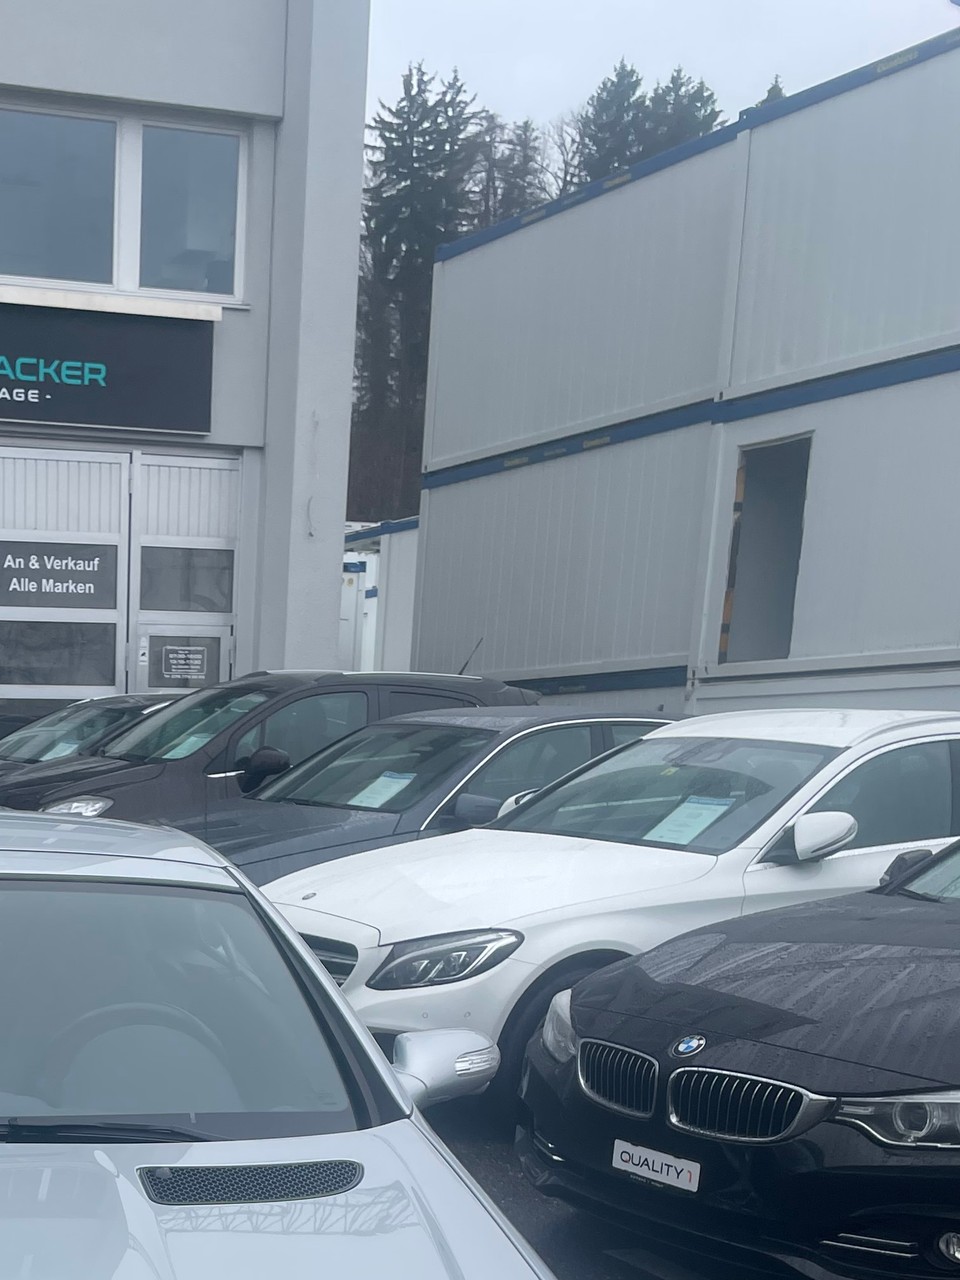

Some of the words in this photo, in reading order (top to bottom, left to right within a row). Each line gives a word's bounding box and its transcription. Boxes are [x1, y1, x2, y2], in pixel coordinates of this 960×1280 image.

[3, 554, 25, 569] An
[28, 555, 40, 570] &
[43, 556, 100, 572] Verkauf
[8, 577, 38, 593] Alle
[41, 578, 95, 594] Marken
[621, 1151, 684, 1180] QUALITY
[686, 1170, 694, 1183] 1
